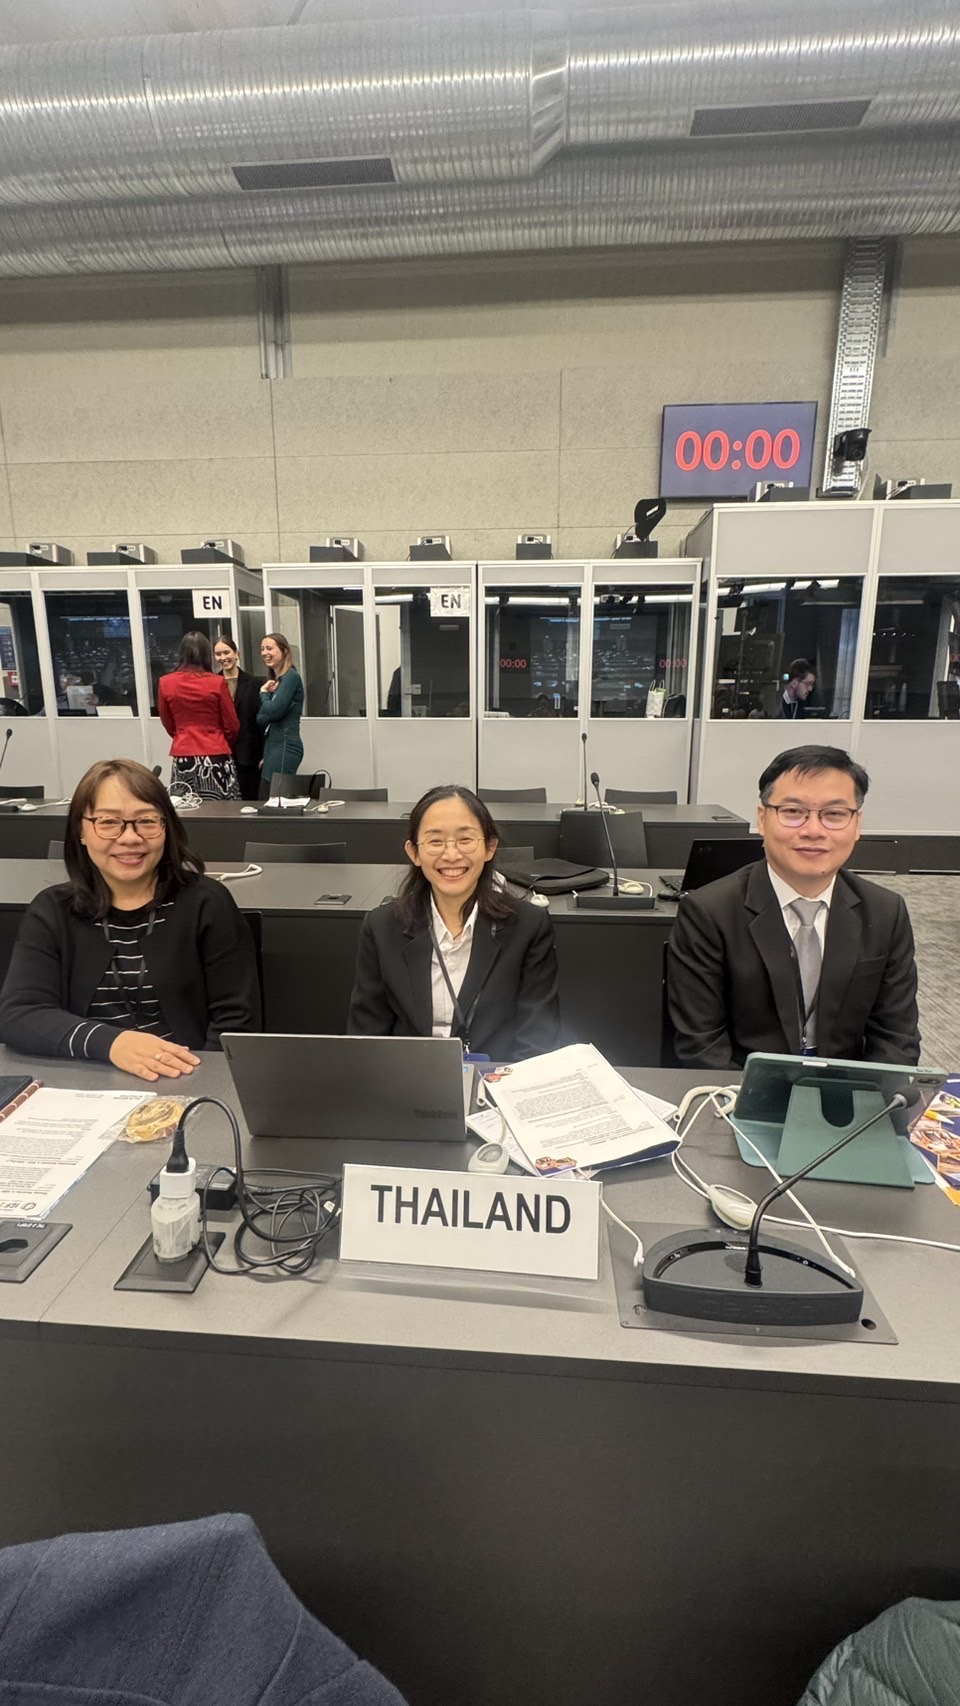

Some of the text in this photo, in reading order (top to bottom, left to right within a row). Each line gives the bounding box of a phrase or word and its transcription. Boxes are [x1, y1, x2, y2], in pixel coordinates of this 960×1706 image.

[675, 428, 800, 471] 00:00
[202, 596, 222, 610] EN
[441, 594, 461, 608] EN
[500, 658, 527, 669] 00:00
[370, 1184, 571, 1234] THAILAND
